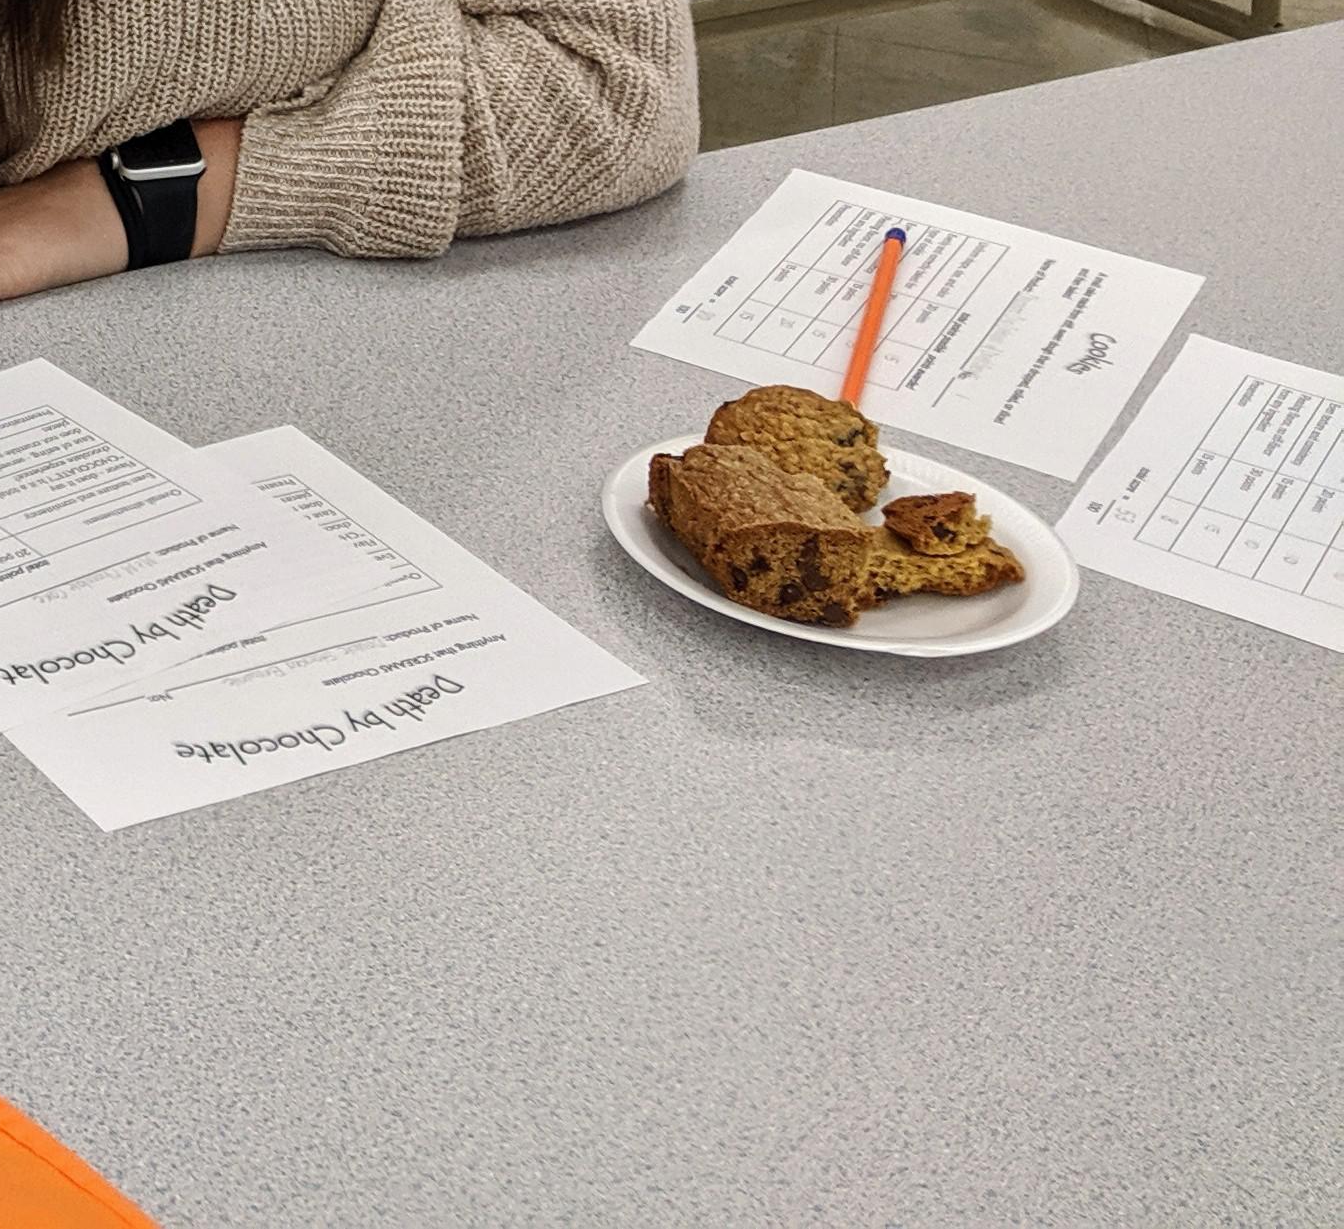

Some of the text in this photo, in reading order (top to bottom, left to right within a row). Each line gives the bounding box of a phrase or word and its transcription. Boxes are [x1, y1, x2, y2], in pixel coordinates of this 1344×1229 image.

[1066, 332, 1117, 375] Cookies
[164, 583, 238, 631] Death
[129, 622, 181, 645] by
[321, 633, 507, 687] Anything that SCREAMS Chocolate
[174, 674, 465, 766] Death by Chocolate
